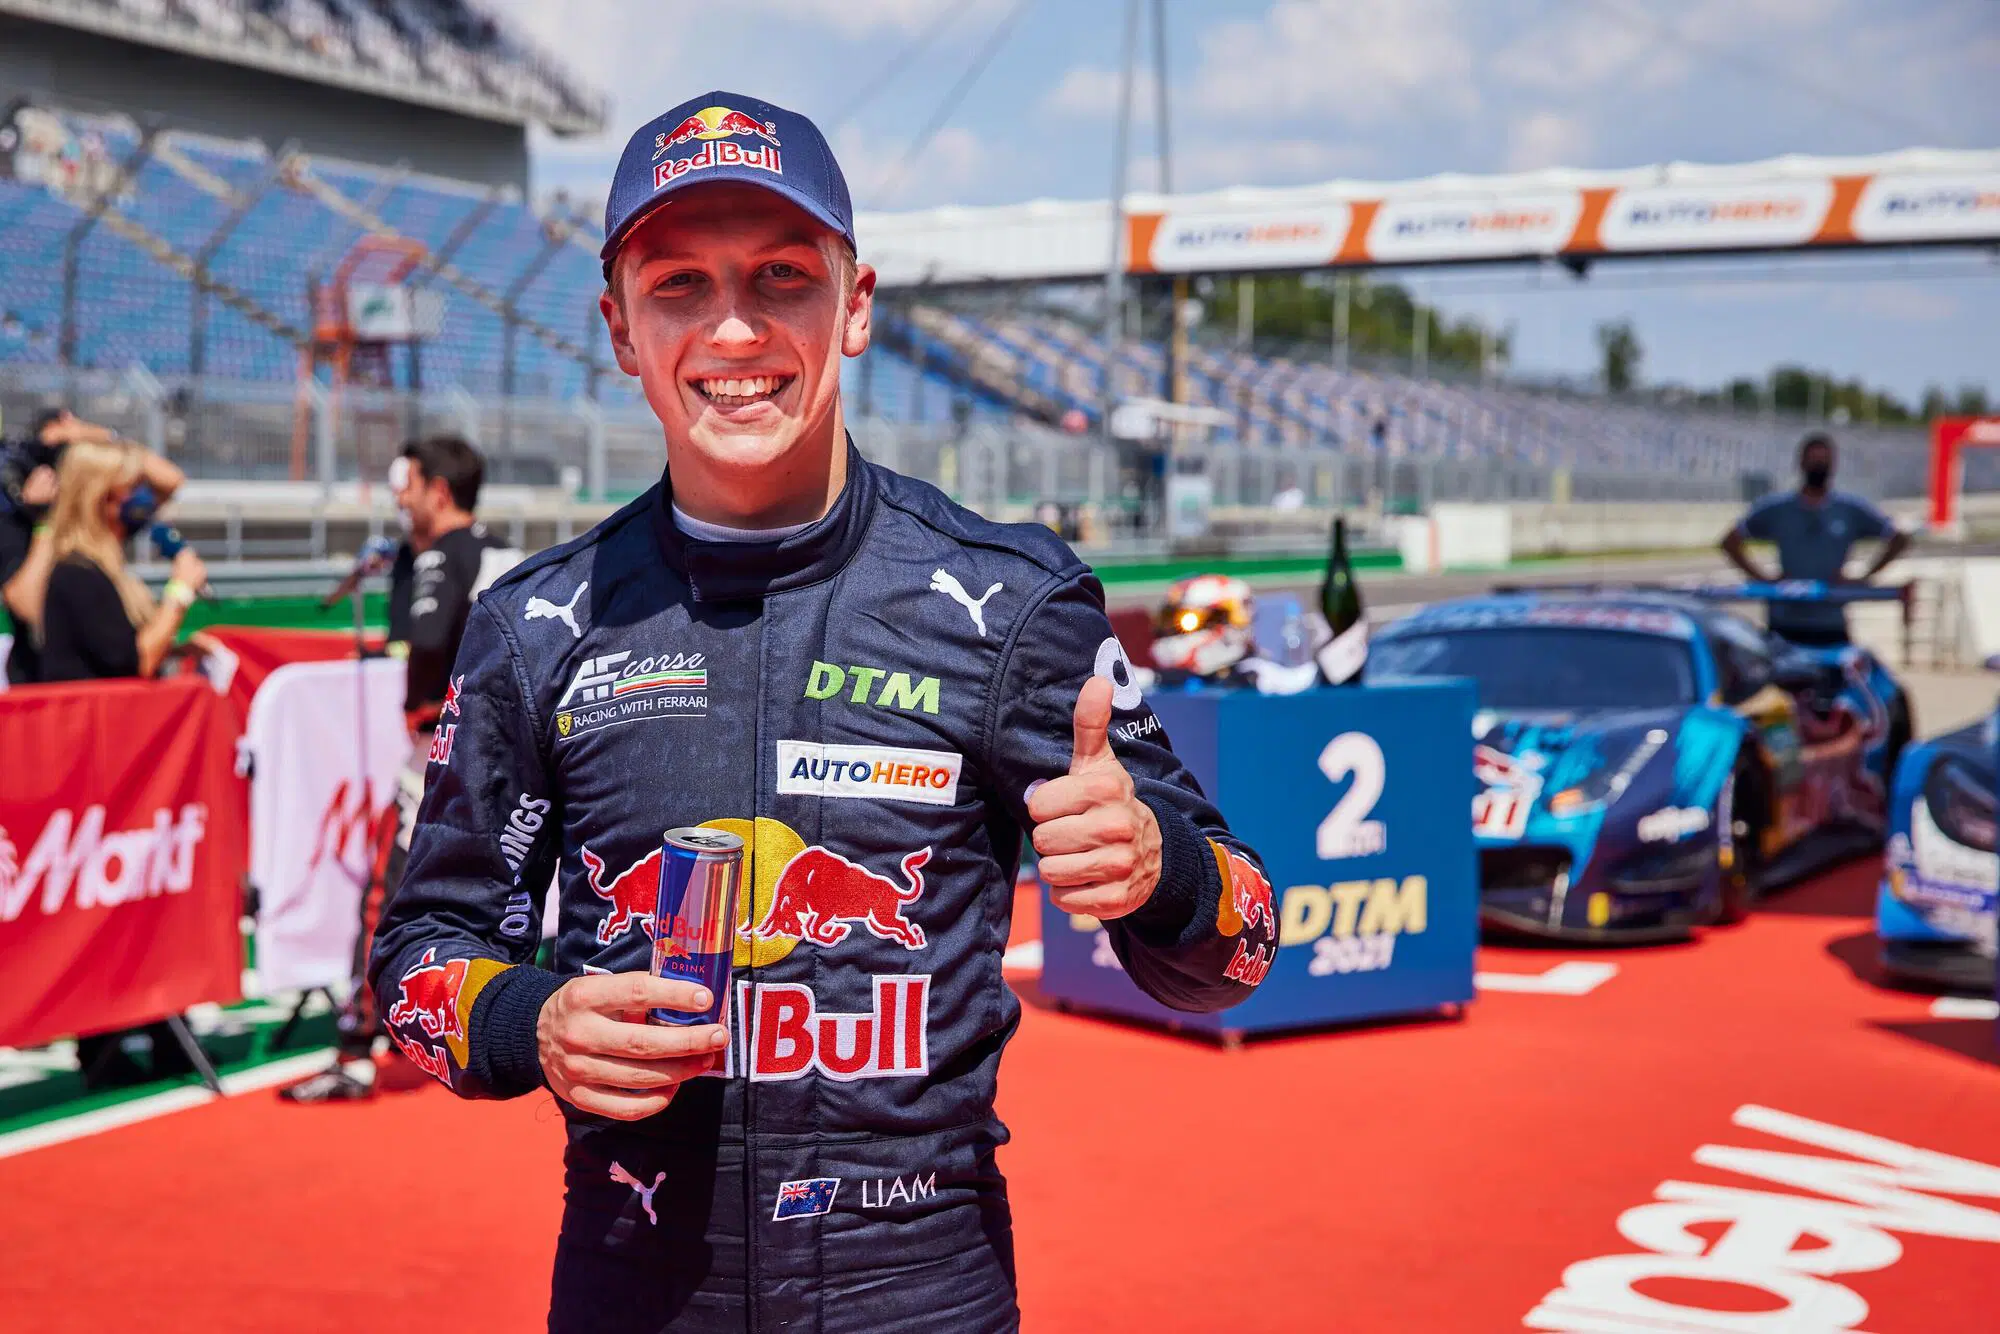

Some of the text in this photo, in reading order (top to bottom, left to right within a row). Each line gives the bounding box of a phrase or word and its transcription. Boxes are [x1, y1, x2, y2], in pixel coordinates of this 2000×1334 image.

[653, 141, 782, 191] Red Bull
[557, 650, 706, 708] AF corse
[804, 660, 941, 715] DTM
[574, 696, 708, 728] RACING WITH FERRARI
[789, 757, 951, 789] AUTOHERO
[1315, 731, 1388, 860] 2
[673, 915, 716, 941] Bull
[1280, 873, 1428, 947] DTM
[671, 960, 706, 974] DRINK
[750, 975, 932, 1082] Bull
[862, 1171, 937, 1209] LIAM
